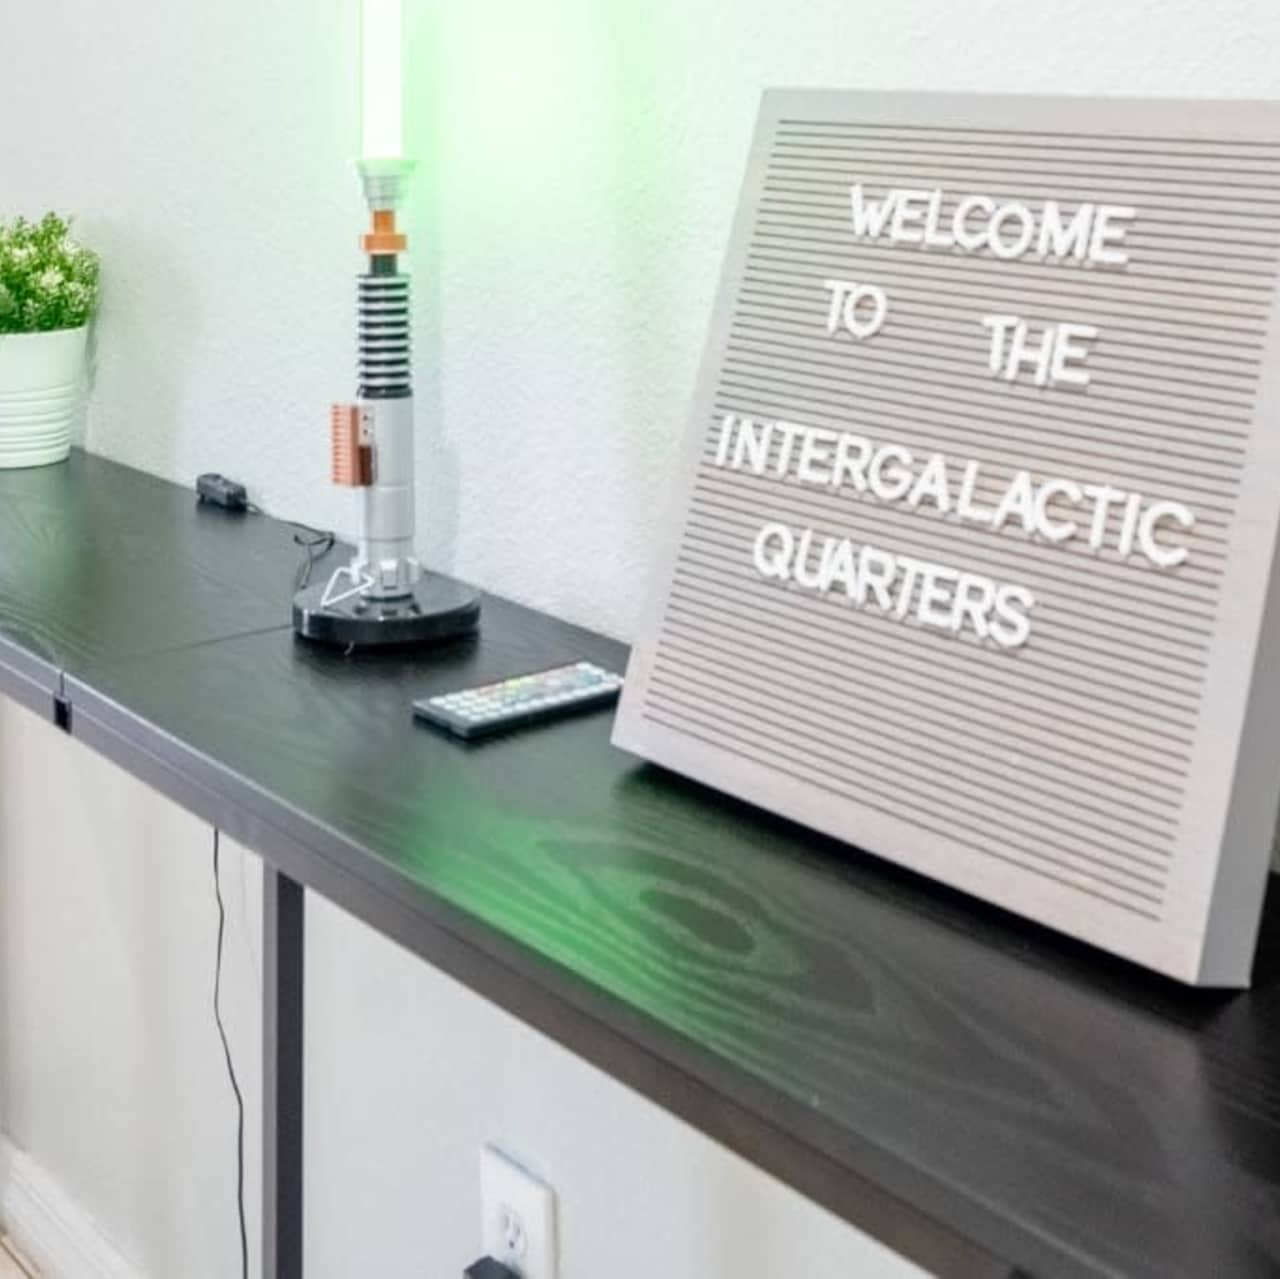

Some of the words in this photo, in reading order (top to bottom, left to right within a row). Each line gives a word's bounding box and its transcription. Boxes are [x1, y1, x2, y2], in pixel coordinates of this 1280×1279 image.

[850, 184, 1136, 264] WELCOME
[823, 279, 887, 338] TO
[981, 317, 1098, 387] THE
[714, 415, 1195, 567] INTERGALACTIC
[753, 523, 1035, 647] QUARTERS
